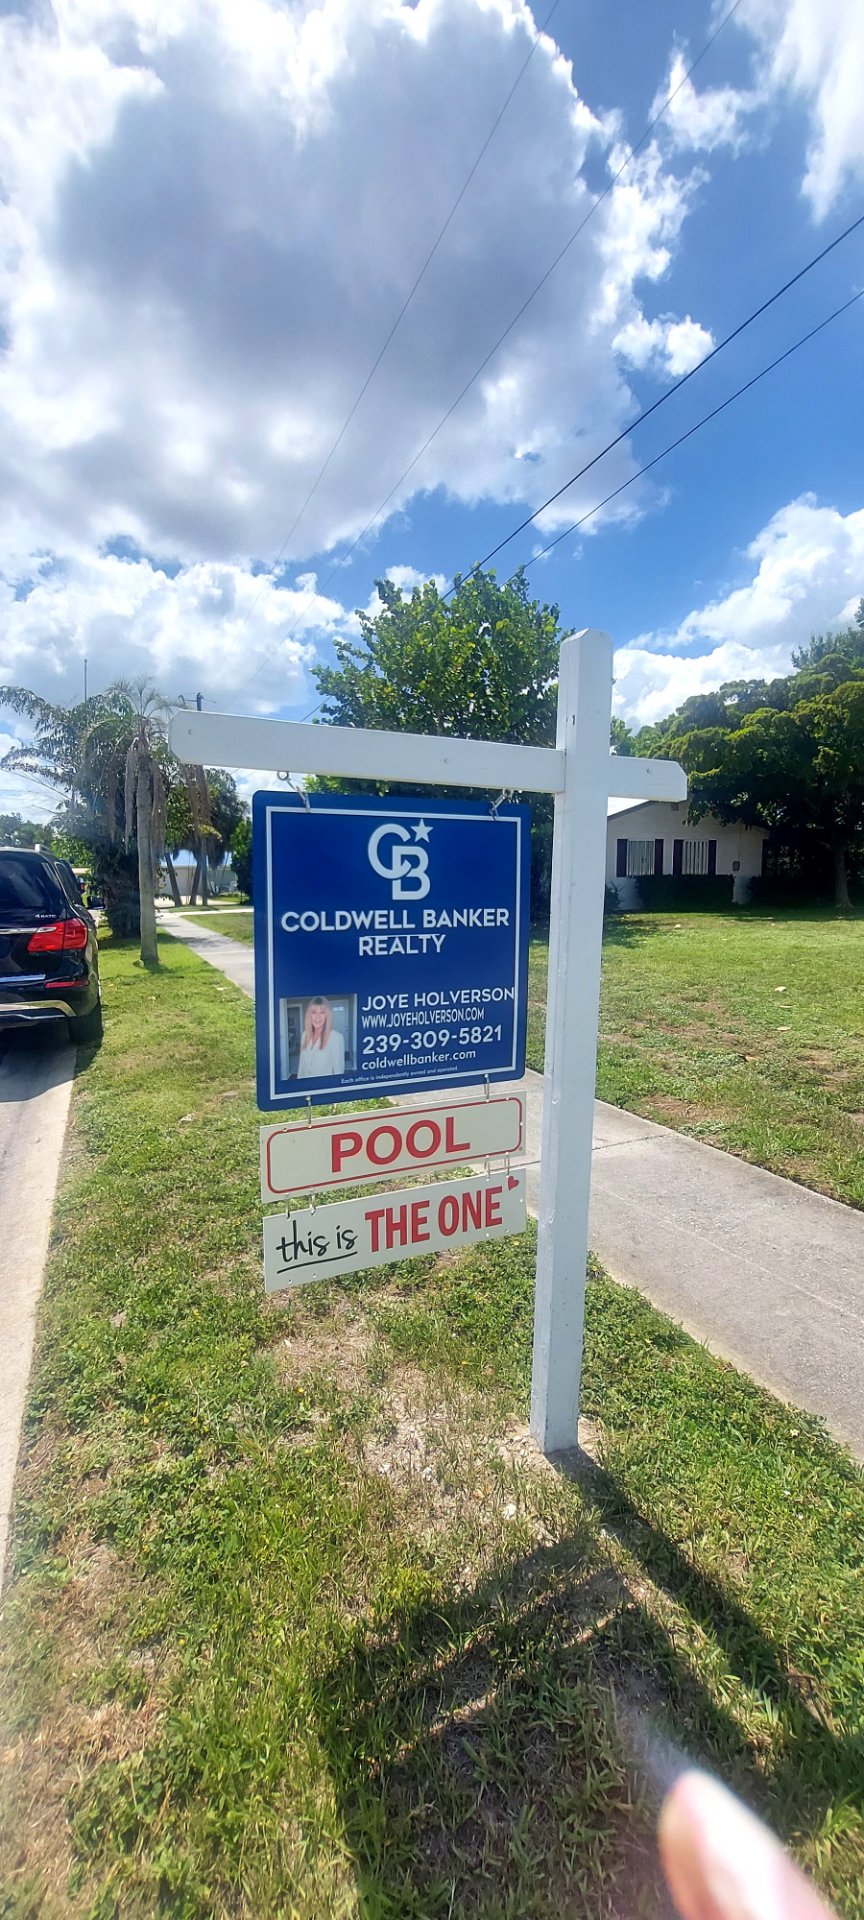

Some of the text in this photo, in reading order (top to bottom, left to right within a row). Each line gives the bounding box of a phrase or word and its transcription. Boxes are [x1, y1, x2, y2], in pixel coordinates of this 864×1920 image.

[281, 908, 510, 932] COLDWELL BANKER
[358, 934, 446, 956] REALTY
[361, 986, 515, 1012] JOYE HOLVERSON
[361, 1006, 485, 1030] WWW.JOYEHOLVERSON.COM
[362, 1024, 502, 1055] 239-309-5821
[361, 1050, 476, 1071] coldwellbanker.com
[355, 1075, 370, 1083] office
[375, 1070, 409, 1080] independently
[410, 1069, 426, 1077] owned
[331, 1116, 471, 1173] POOL
[276, 1186, 503, 1263] this is THE ONE
